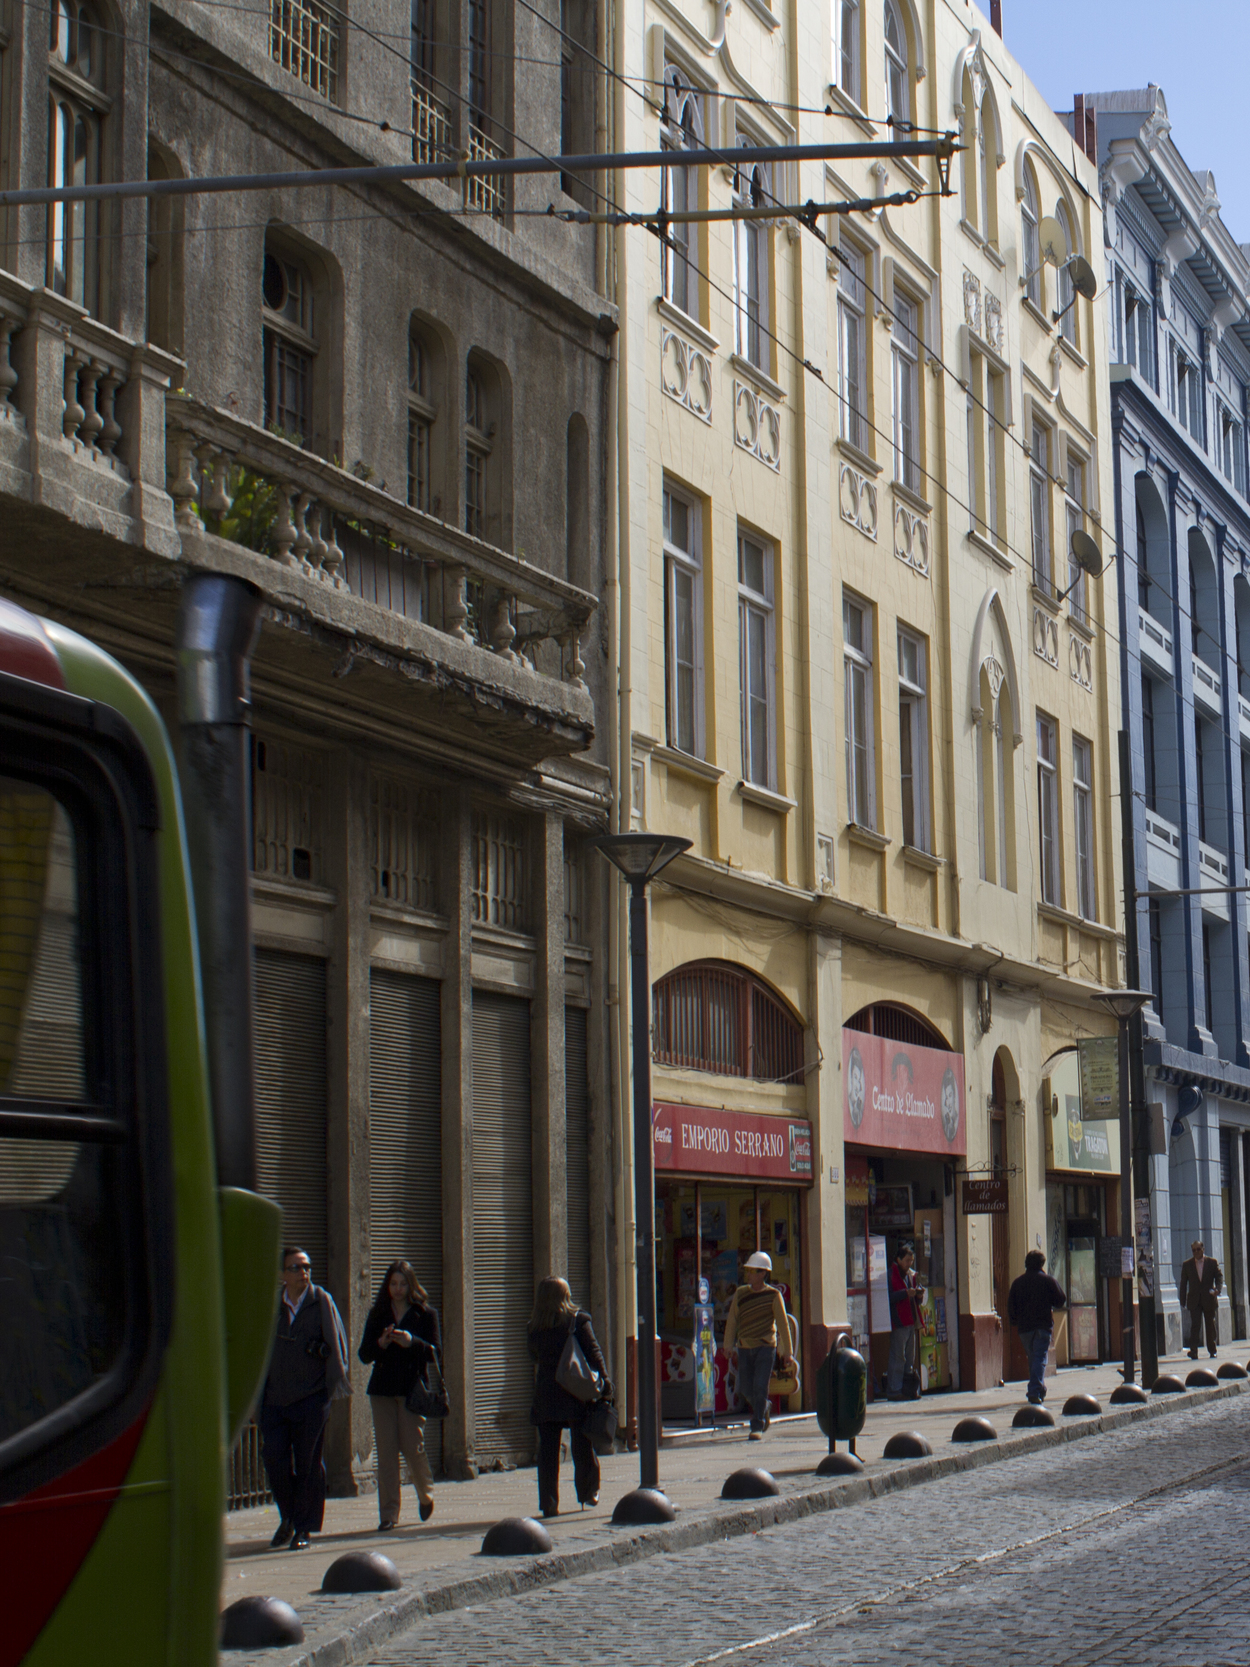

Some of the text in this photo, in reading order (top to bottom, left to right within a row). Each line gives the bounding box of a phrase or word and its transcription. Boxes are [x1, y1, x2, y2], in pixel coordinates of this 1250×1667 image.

[872, 1085, 895, 1113] Centro
[896, 1090, 904, 1115] de
[681, 1123, 784, 1157] EMPORIO SERRANO
[969, 1180, 1001, 1190] Centro
[979, 1189, 991, 1200] de
[964, 1199, 1006, 1212] llamados
